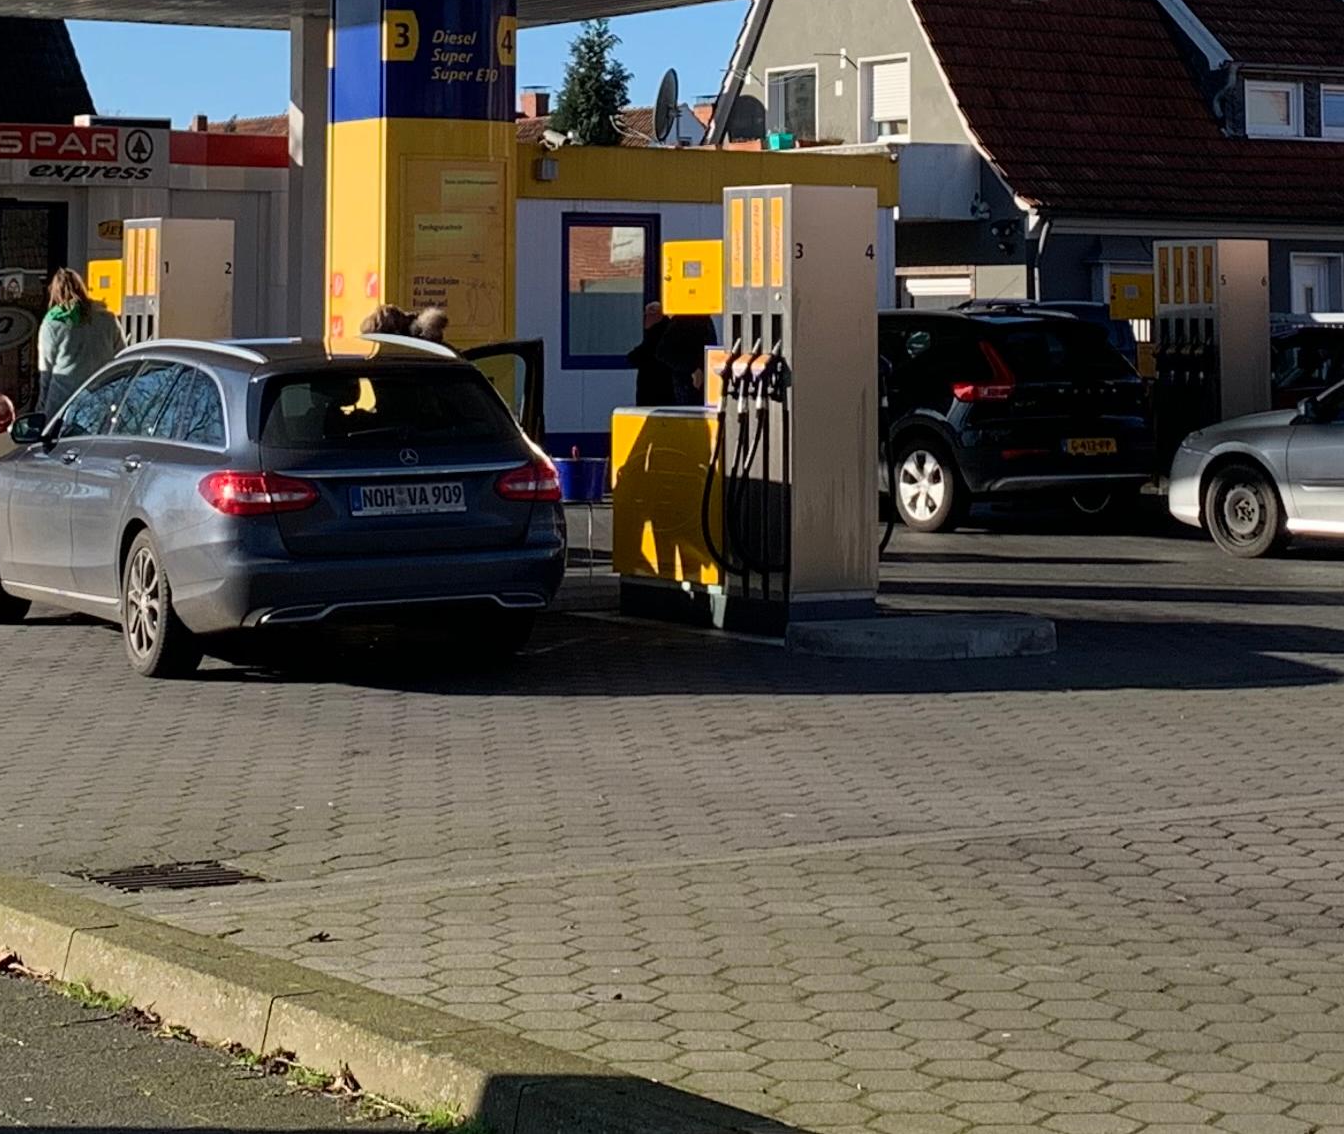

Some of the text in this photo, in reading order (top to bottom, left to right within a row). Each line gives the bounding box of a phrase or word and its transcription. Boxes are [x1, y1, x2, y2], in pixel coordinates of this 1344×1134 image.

[395, 23, 410, 48] 3
[432, 29, 477, 45] Diesel
[501, 30, 513, 54] 4
[431, 48, 473, 66] Super
[431, 66, 498, 83] Super E10
[29, 164, 152, 182] express
[795, 243, 803, 259] 3
[865, 244, 875, 260] 4
[164, 261, 169, 274] 1
[225, 262, 232, 275] 2
[1221, 275, 1227, 286] 5
[362, 485, 462, 507] NOH VA 909
